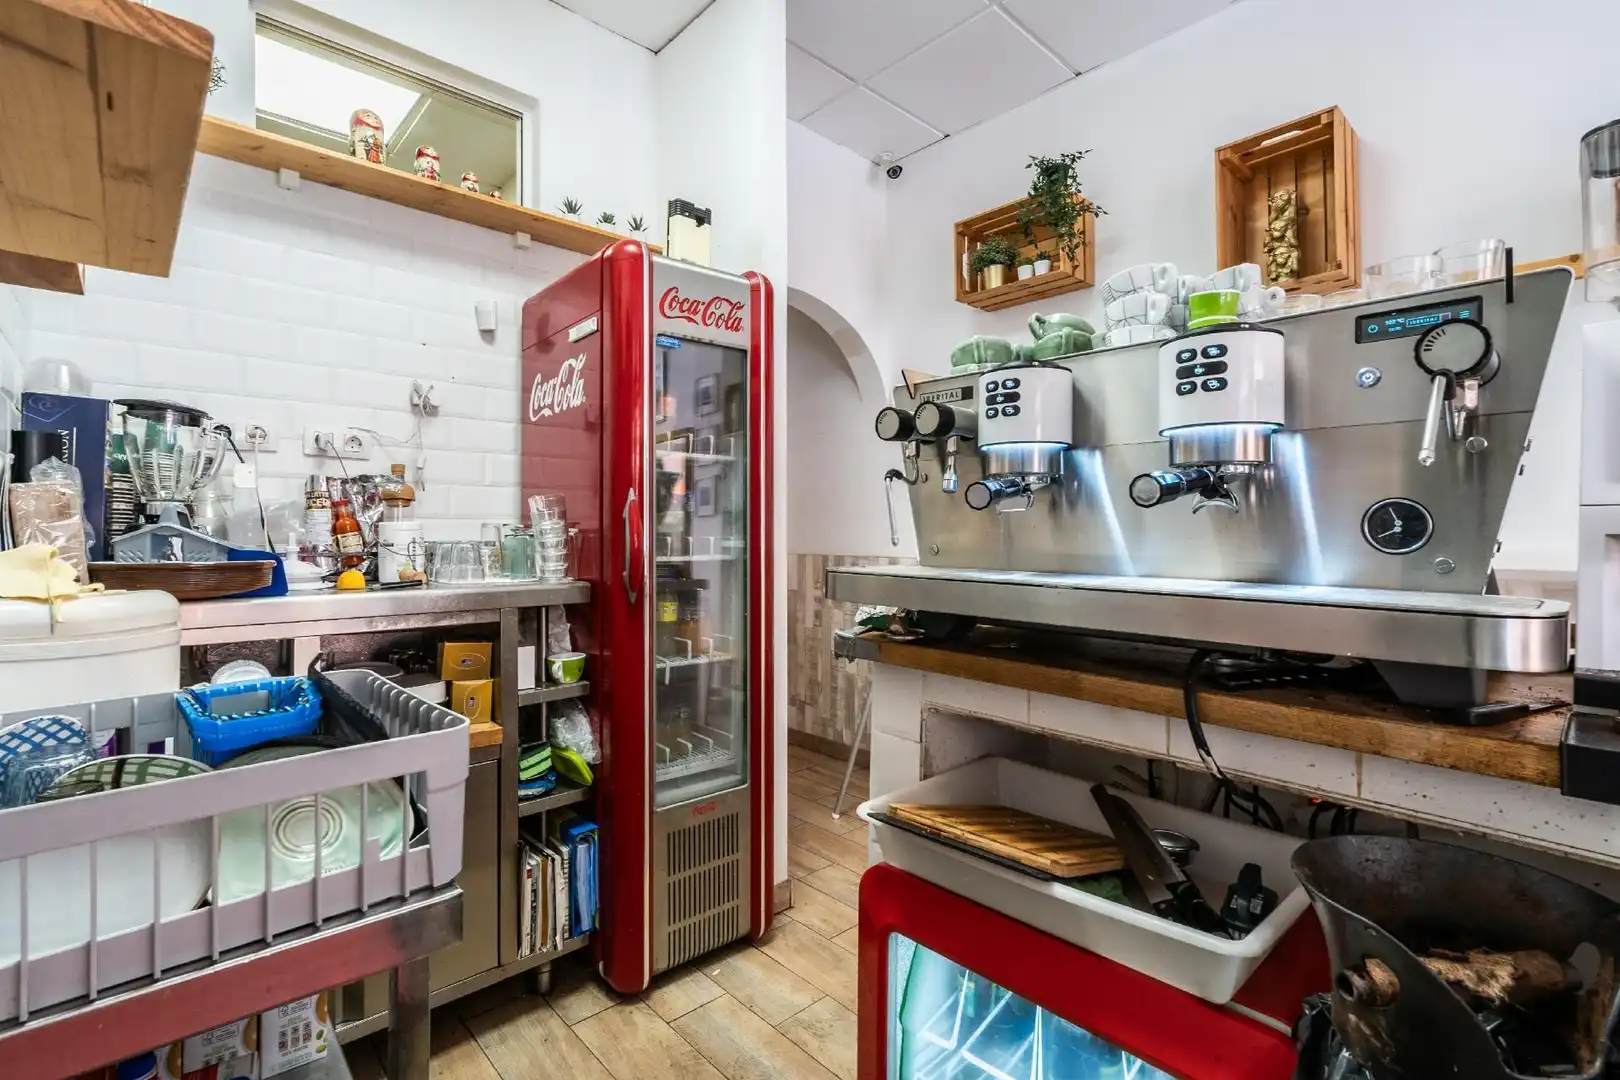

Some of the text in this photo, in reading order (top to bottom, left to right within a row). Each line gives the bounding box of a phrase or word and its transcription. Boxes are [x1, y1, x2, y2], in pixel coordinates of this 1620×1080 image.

[659, 286, 745, 333] Coca-Cola
[529, 352, 587, 422] Coca-Cola
[922, 391, 959, 402] IBERITAL
